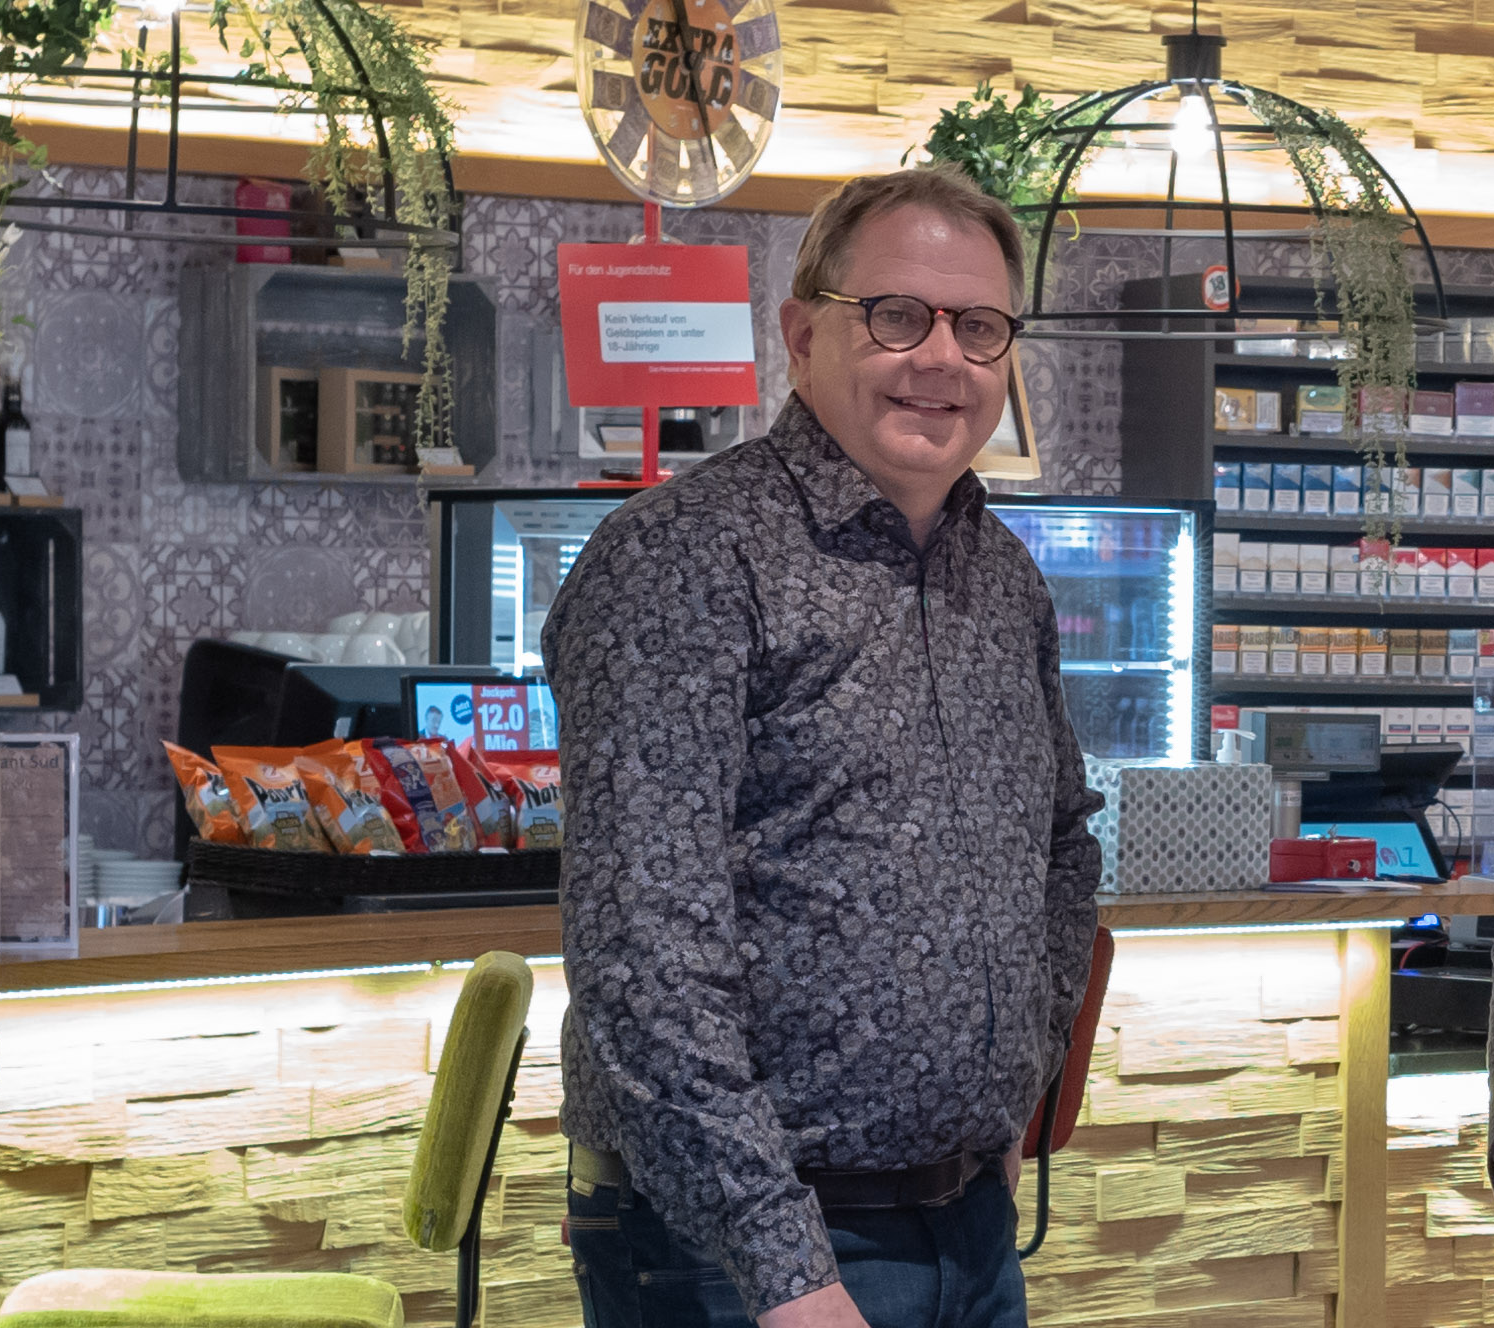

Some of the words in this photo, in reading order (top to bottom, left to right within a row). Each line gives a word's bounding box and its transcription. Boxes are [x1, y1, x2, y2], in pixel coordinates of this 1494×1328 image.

[642, 18, 734, 66] EXTRA
[641, 52, 733, 108] GOLD
[568, 264, 584, 275] Für
[586, 264, 604, 275] den
[604, 314, 628, 324] Kein
[630, 314, 668, 324] Verkauf
[669, 316, 687, 324] von
[605, 327, 665, 340] Geldspielen
[666, 329, 680, 338] an
[681, 328, 705, 338] unter
[607, 341, 660, 353] 18-Jährige
[478, 704, 525, 732] 12.0
